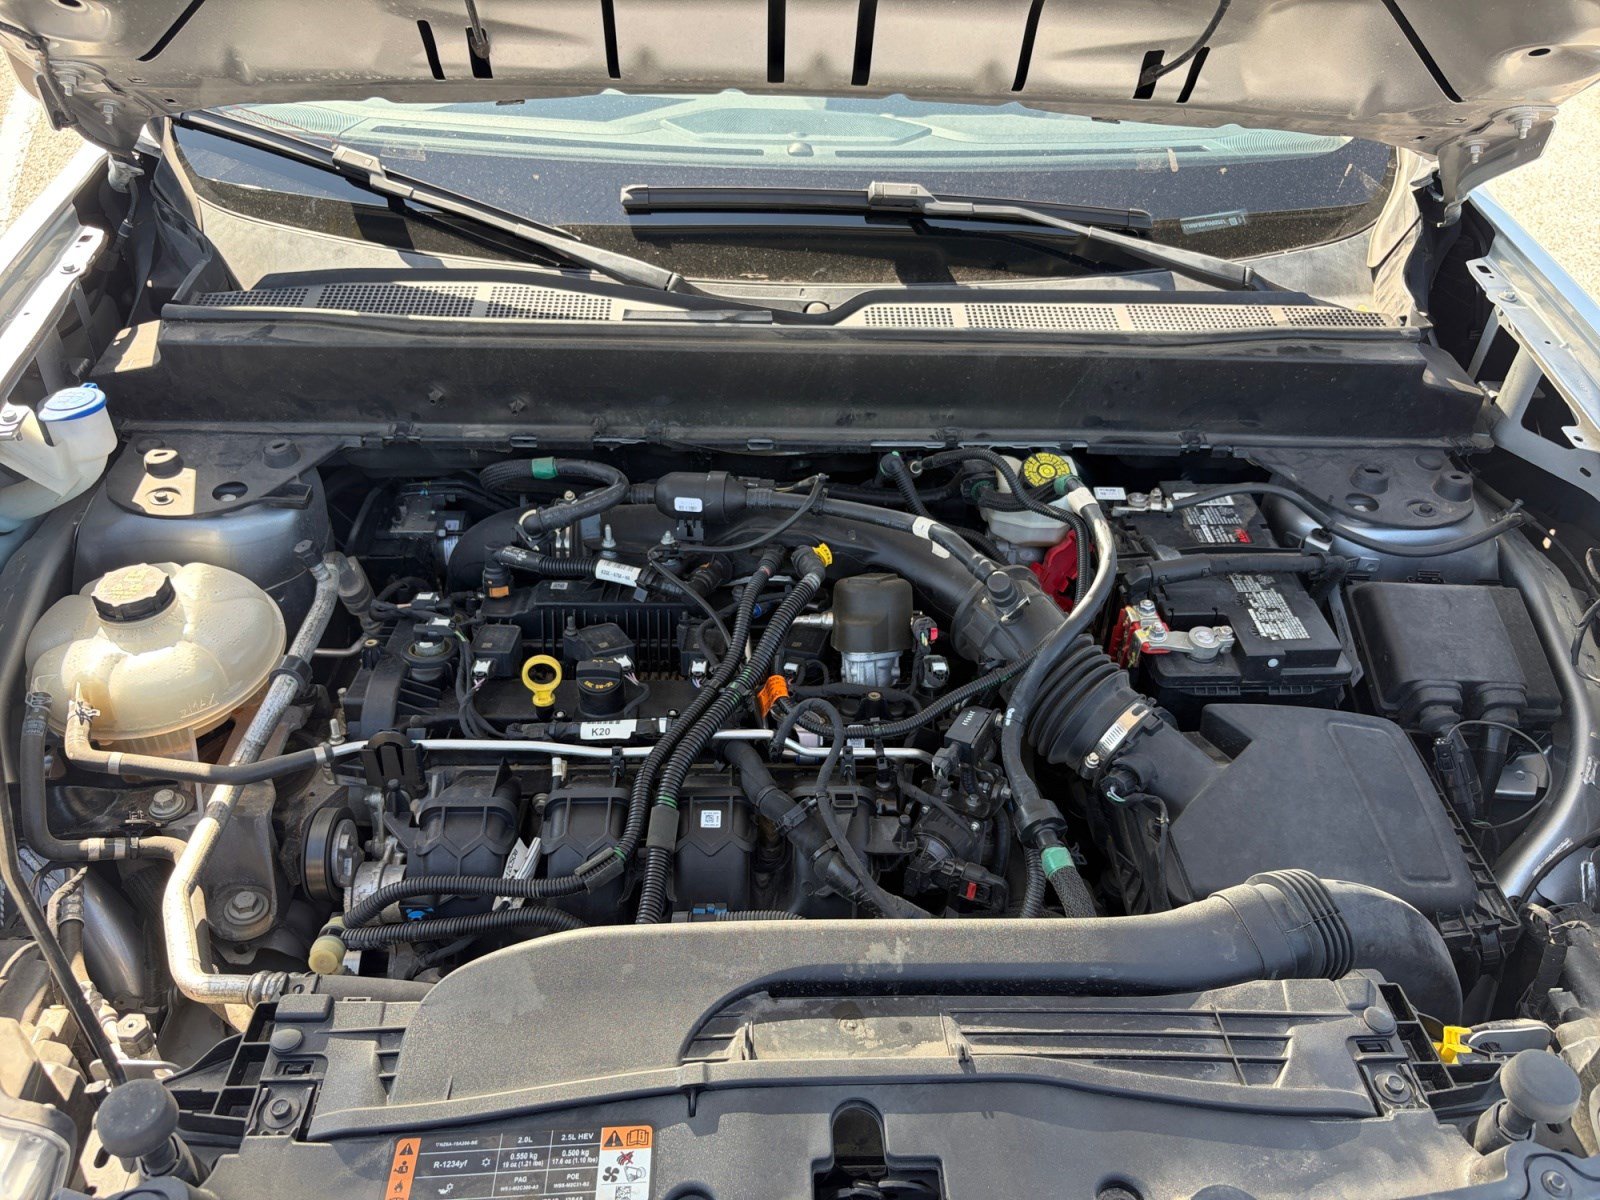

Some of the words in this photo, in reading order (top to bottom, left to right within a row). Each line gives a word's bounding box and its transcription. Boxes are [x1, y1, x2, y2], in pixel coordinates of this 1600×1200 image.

[591, 727, 611, 737] K20
[517, 1136, 533, 1144] 2.0L
[578, 1132, 594, 1140] HEV
[510, 1152, 528, 1160] 0.550
[529, 1152, 538, 1160] kg
[561, 1149, 579, 1157] 0.500
[581, 1149, 590, 1157] kg
[433, 1159, 468, 1169] R-1234yf
[572, 1157, 586, 1165] (1.10
[587, 1156, 599, 1164] lbs)
